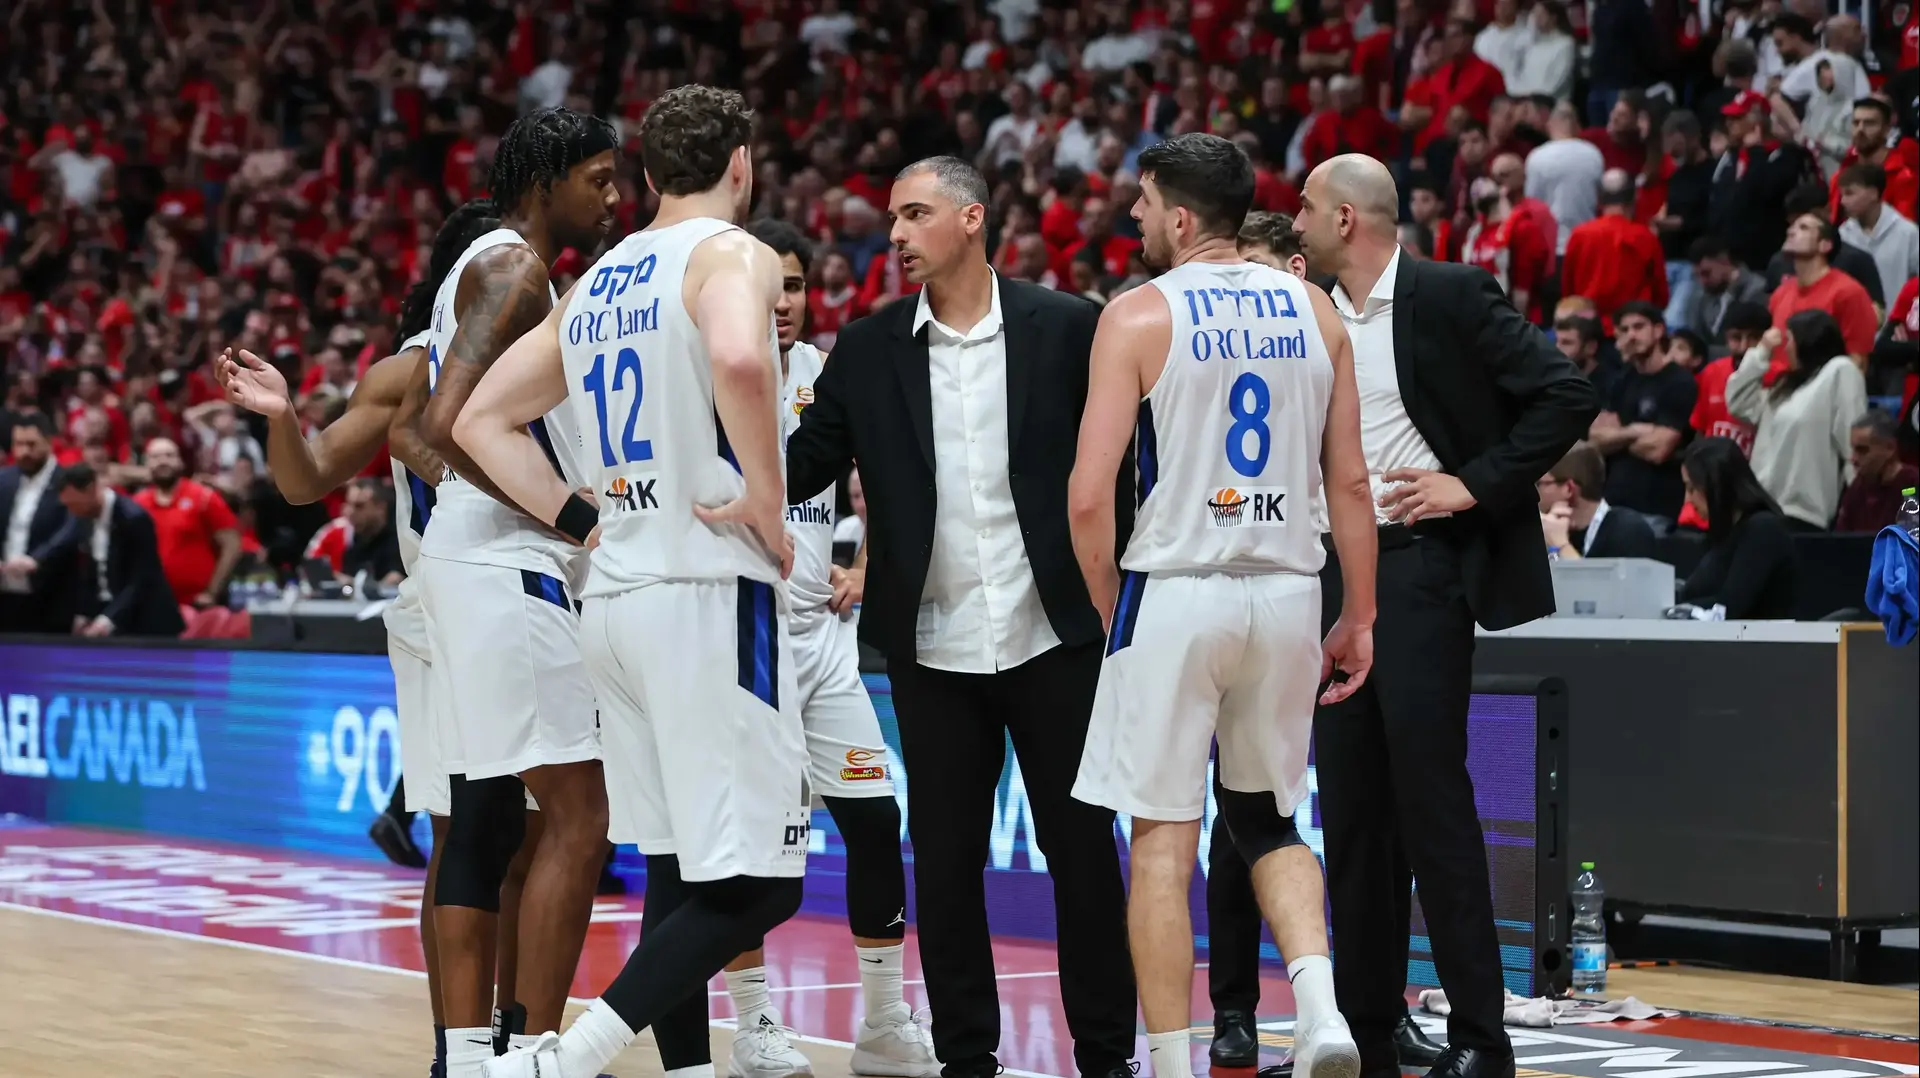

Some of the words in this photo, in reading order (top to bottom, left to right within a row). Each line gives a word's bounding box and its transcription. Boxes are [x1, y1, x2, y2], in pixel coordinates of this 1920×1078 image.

[589, 253, 657, 304] מקס
[569, 310, 612, 346] ORC
[1192, 328, 1240, 361] ORC
[1243, 329, 1306, 359] Land
[583, 347, 654, 467] 12
[1225, 372, 1271, 478] 8
[623, 479, 659, 511] RK
[786, 501, 831, 524] nlink
[1254, 493, 1285, 521] RK
[46, 696, 207, 791] CANADA
